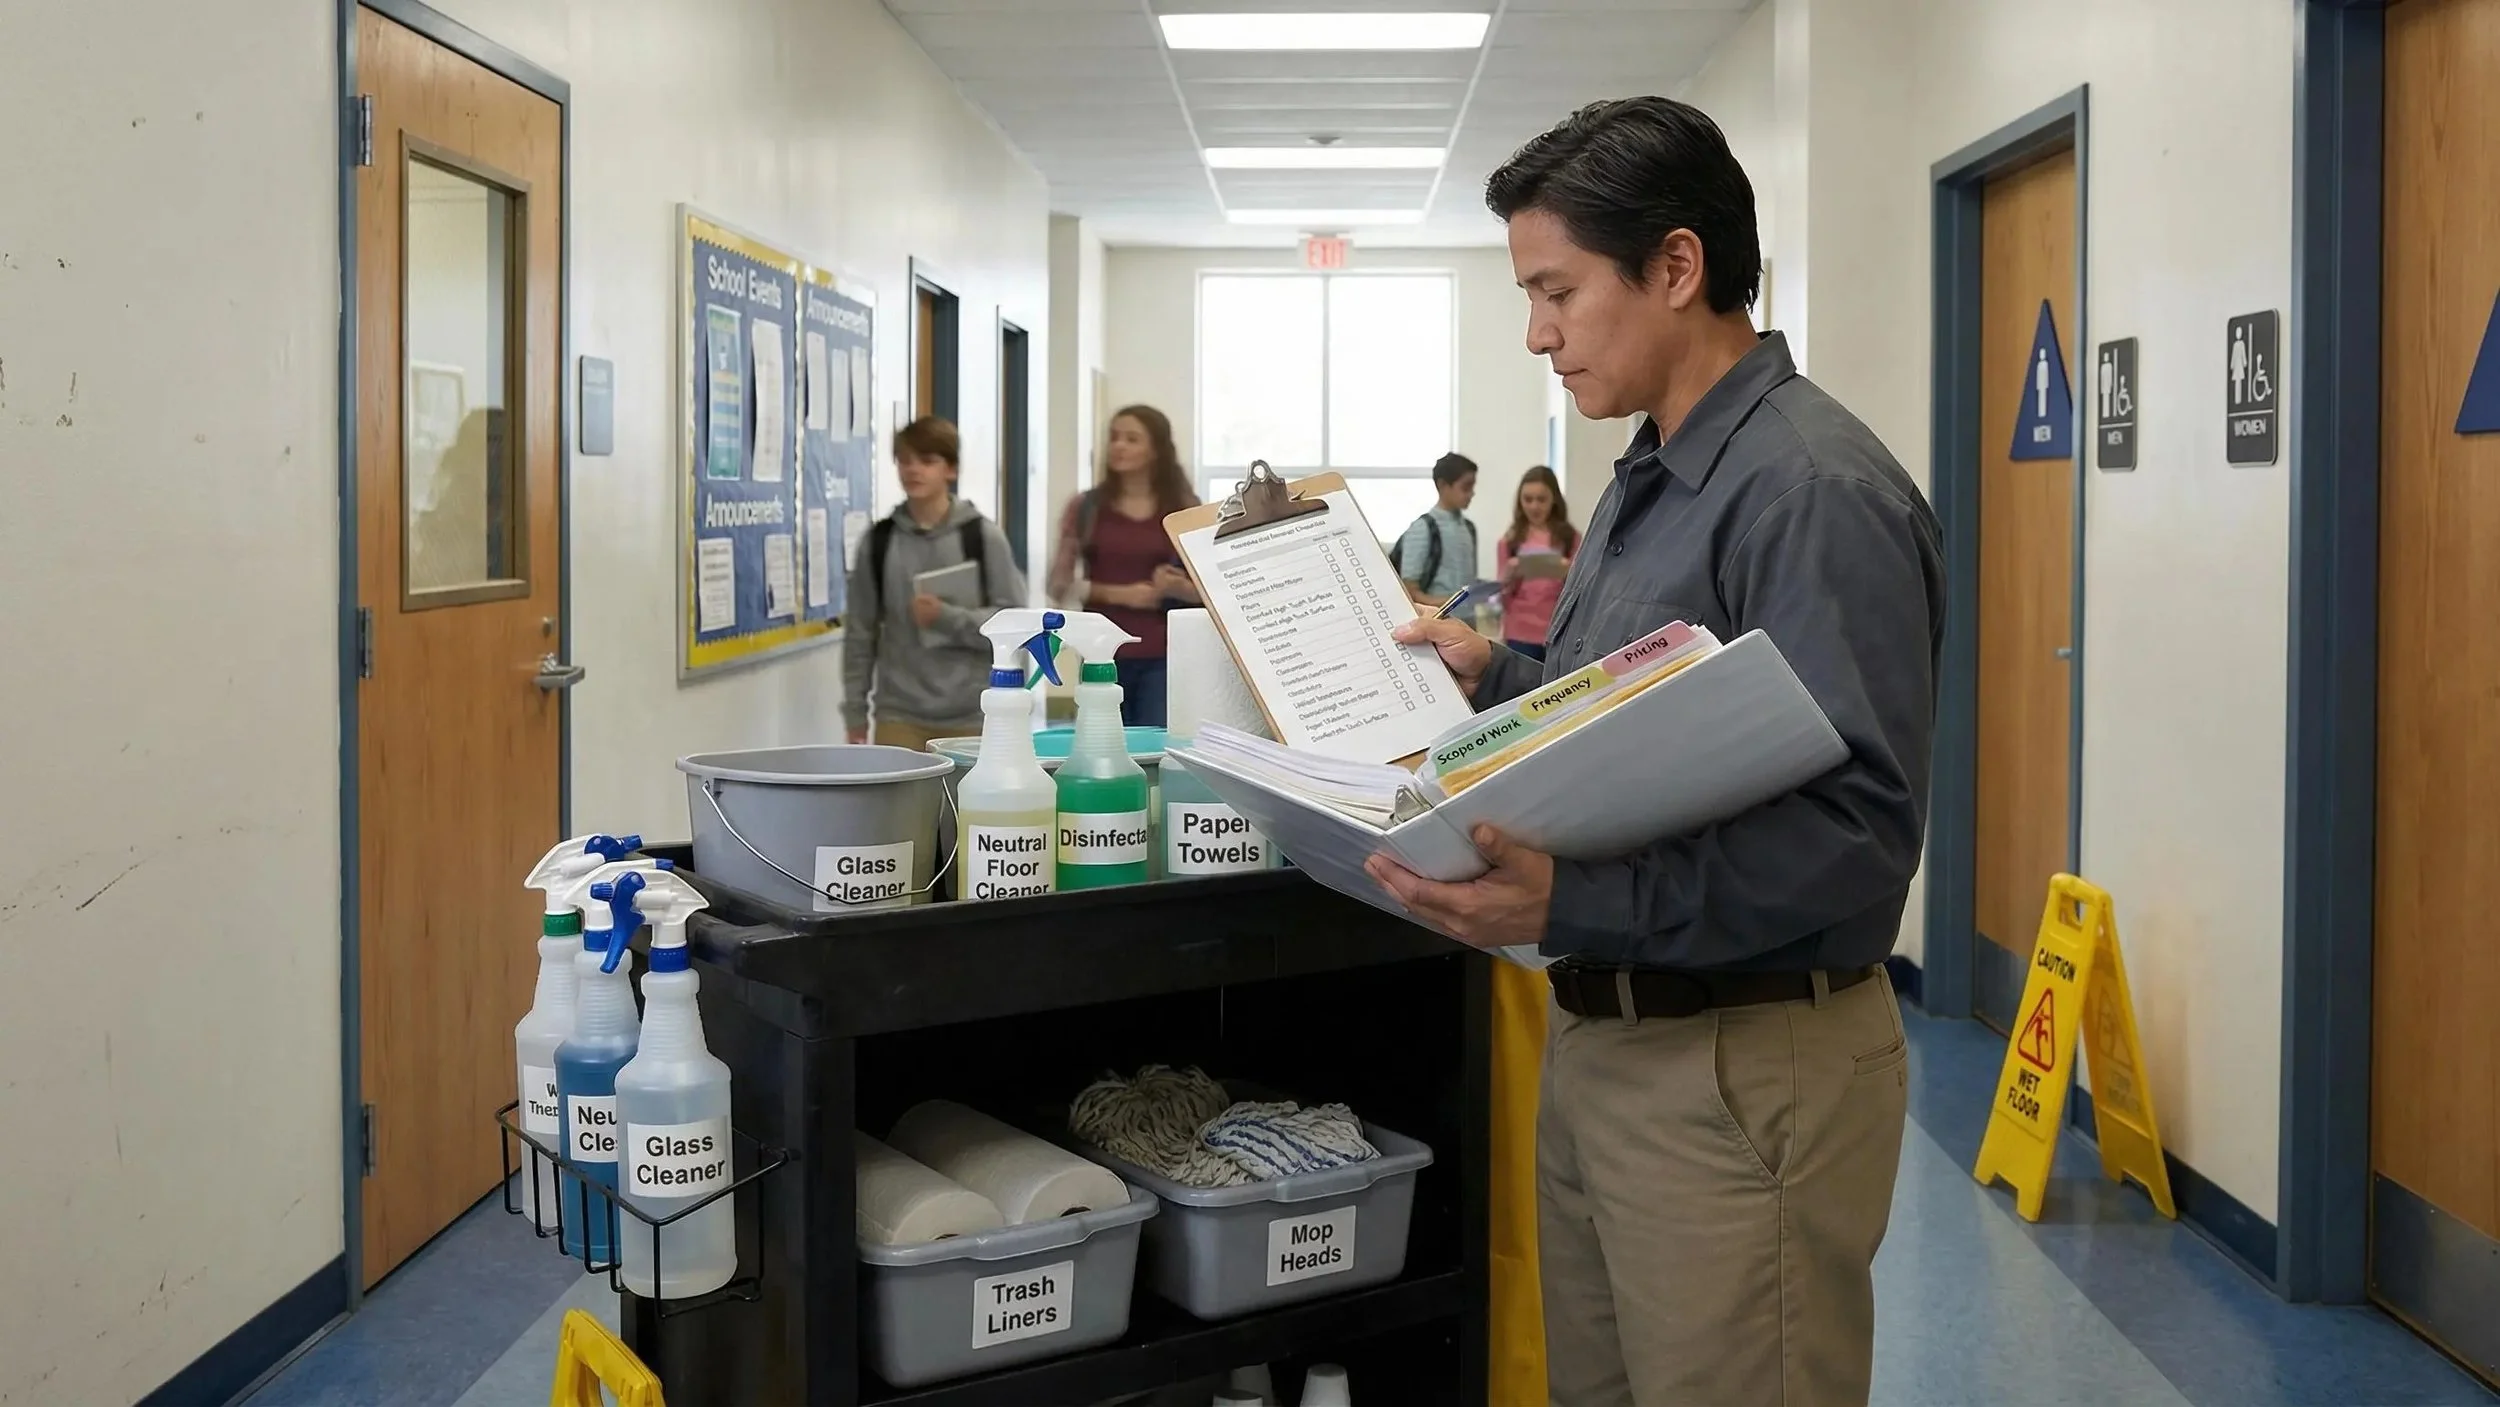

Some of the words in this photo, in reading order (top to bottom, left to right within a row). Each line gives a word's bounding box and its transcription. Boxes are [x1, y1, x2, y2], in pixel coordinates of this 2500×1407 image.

[1307, 239, 1346, 268] EXIT
[707, 255, 747, 298] School
[750, 268, 782, 310] Events
[2234, 418, 2267, 437] WOMEN
[705, 492, 785, 528] Announcements
[1487, 719, 1522, 739] Work
[1183, 812, 1250, 838] Paper
[977, 834, 1048, 853] Neutral
[1177, 842, 1260, 864] Towels
[836, 856, 897, 876] Glass
[987, 858, 1039, 877] Floor
[826, 881, 906, 901] Cleaner
[976, 881, 1049, 900] Cleaner
[2037, 948, 2076, 983] CAUTION
[2017, 1068, 2041, 1095] WET
[2006, 1086, 2041, 1122] FLOOR
[579, 1131, 619, 1152] Cle
[646, 1136, 714, 1157] Glass
[636, 1160, 726, 1186] Cleaner
[1290, 1220, 1334, 1246] Mop
[1280, 1244, 1342, 1273] Heads
[991, 1275, 1056, 1305] Trash
[987, 1304, 1058, 1335] Liners
